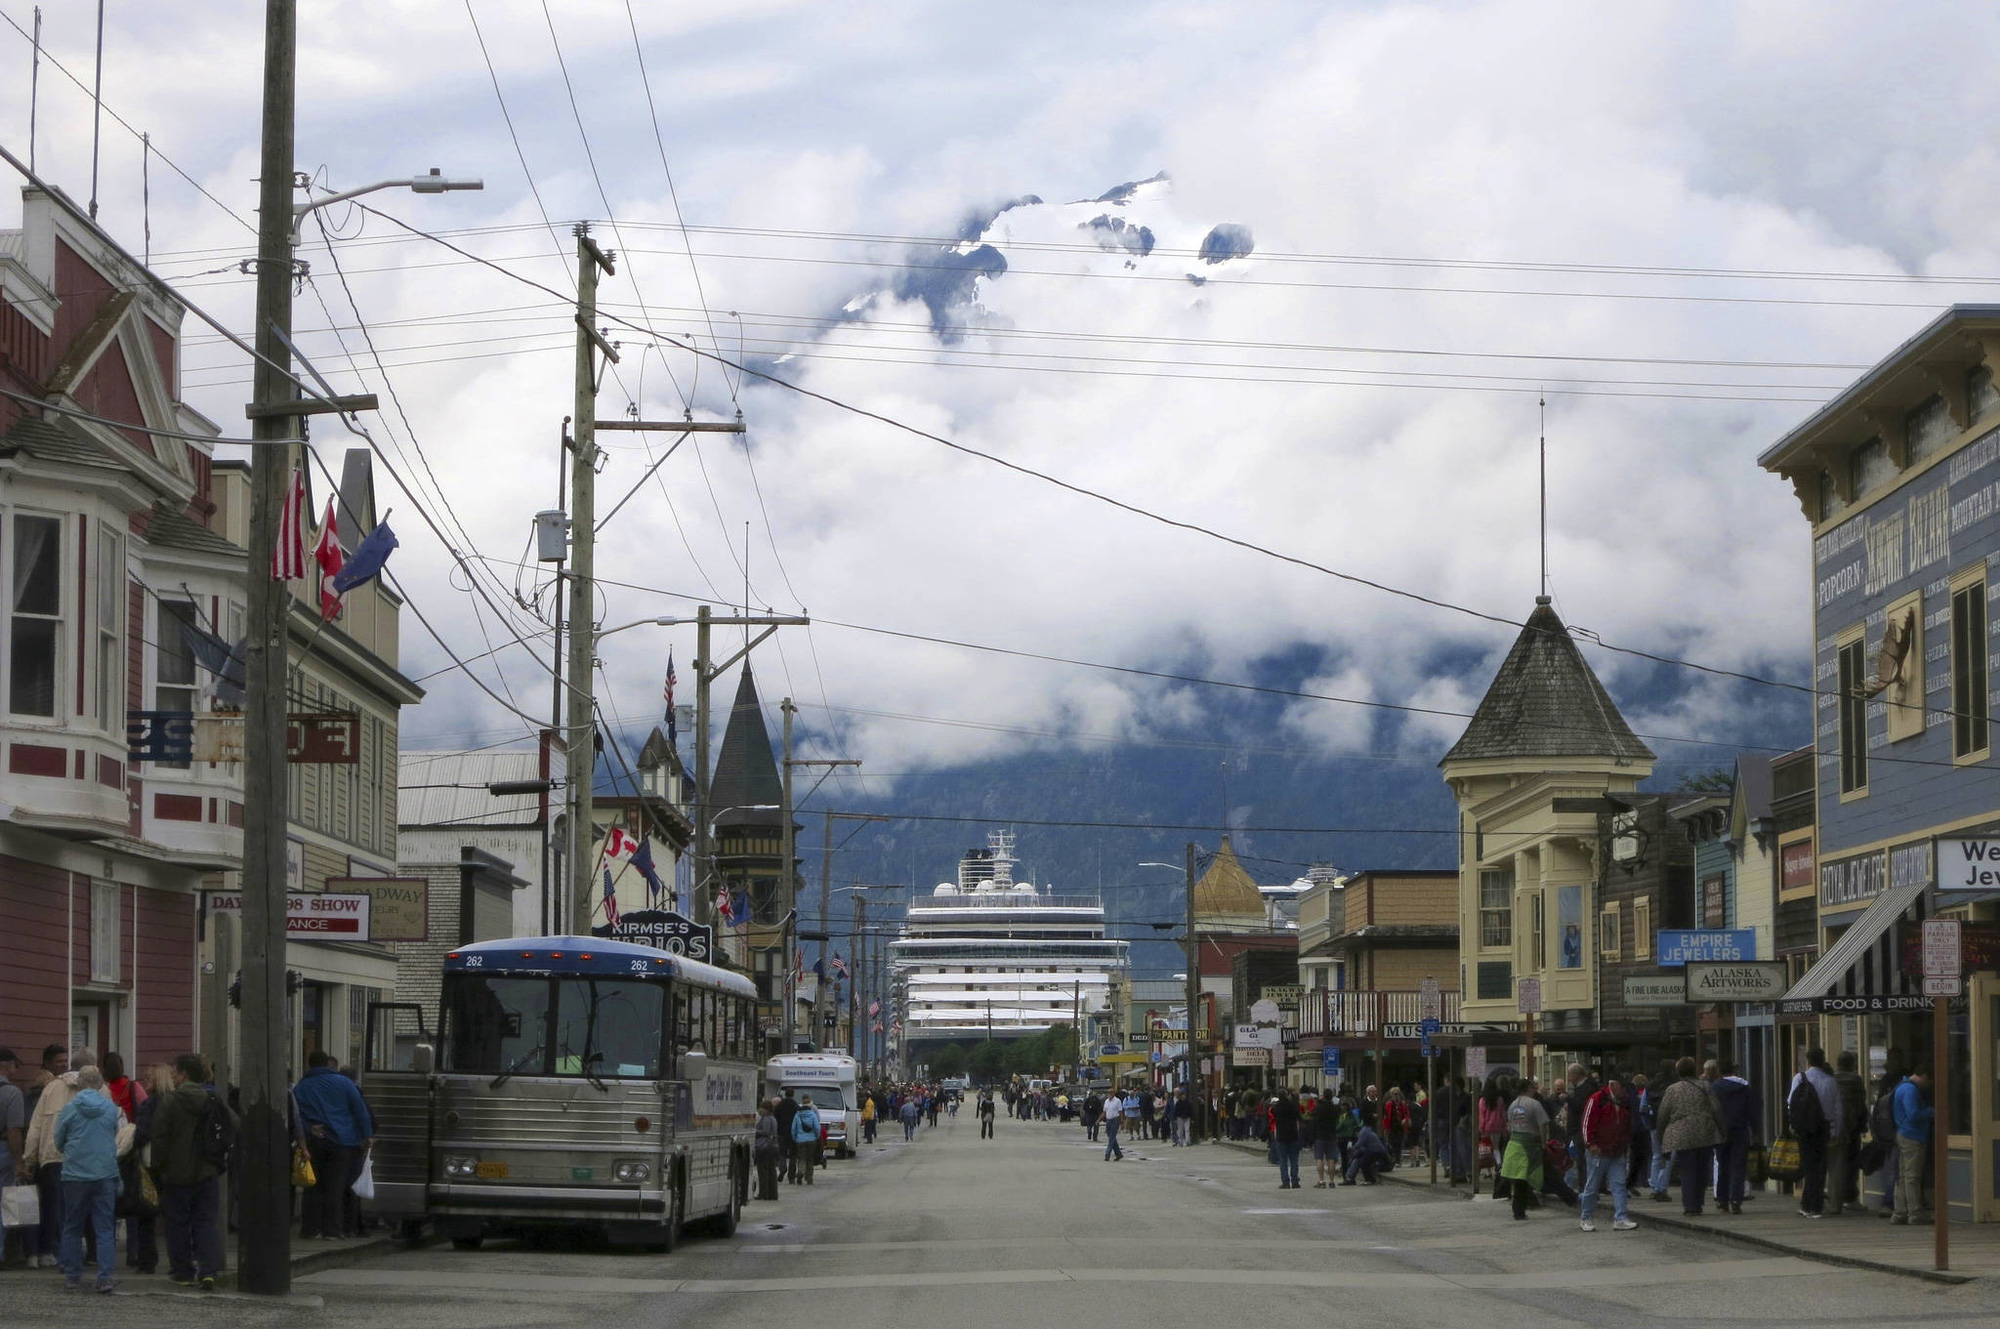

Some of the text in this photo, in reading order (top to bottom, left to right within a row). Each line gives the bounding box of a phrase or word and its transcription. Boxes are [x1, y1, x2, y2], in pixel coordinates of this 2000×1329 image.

[1951, 485, 1993, 532] MOUNTAIN
[1819, 561, 1861, 606] POPCORN
[1822, 863, 1847, 906] ROYAL
[310, 899, 360, 912] SHOW
[612, 922, 690, 934] KIRMSE'S
[1680, 934, 1733, 947] EMPIRE
[466, 955, 483, 967] 262
[1663, 948, 1741, 961] JEWELERS
[630, 959, 648, 971] 262
[1710, 968, 1762, 978] ALASKA
[1700, 974, 1772, 988] ARTWORKS
[1625, 985, 1631, 994] A
[1631, 985, 1646, 995] FINE
[1646, 985, 1660, 994] LINE
[1823, 997, 1935, 1010] FOOD & DRINK
[1161, 1030, 1209, 1040] PANTHON
[1386, 1025, 1465, 1037] MUSUM
